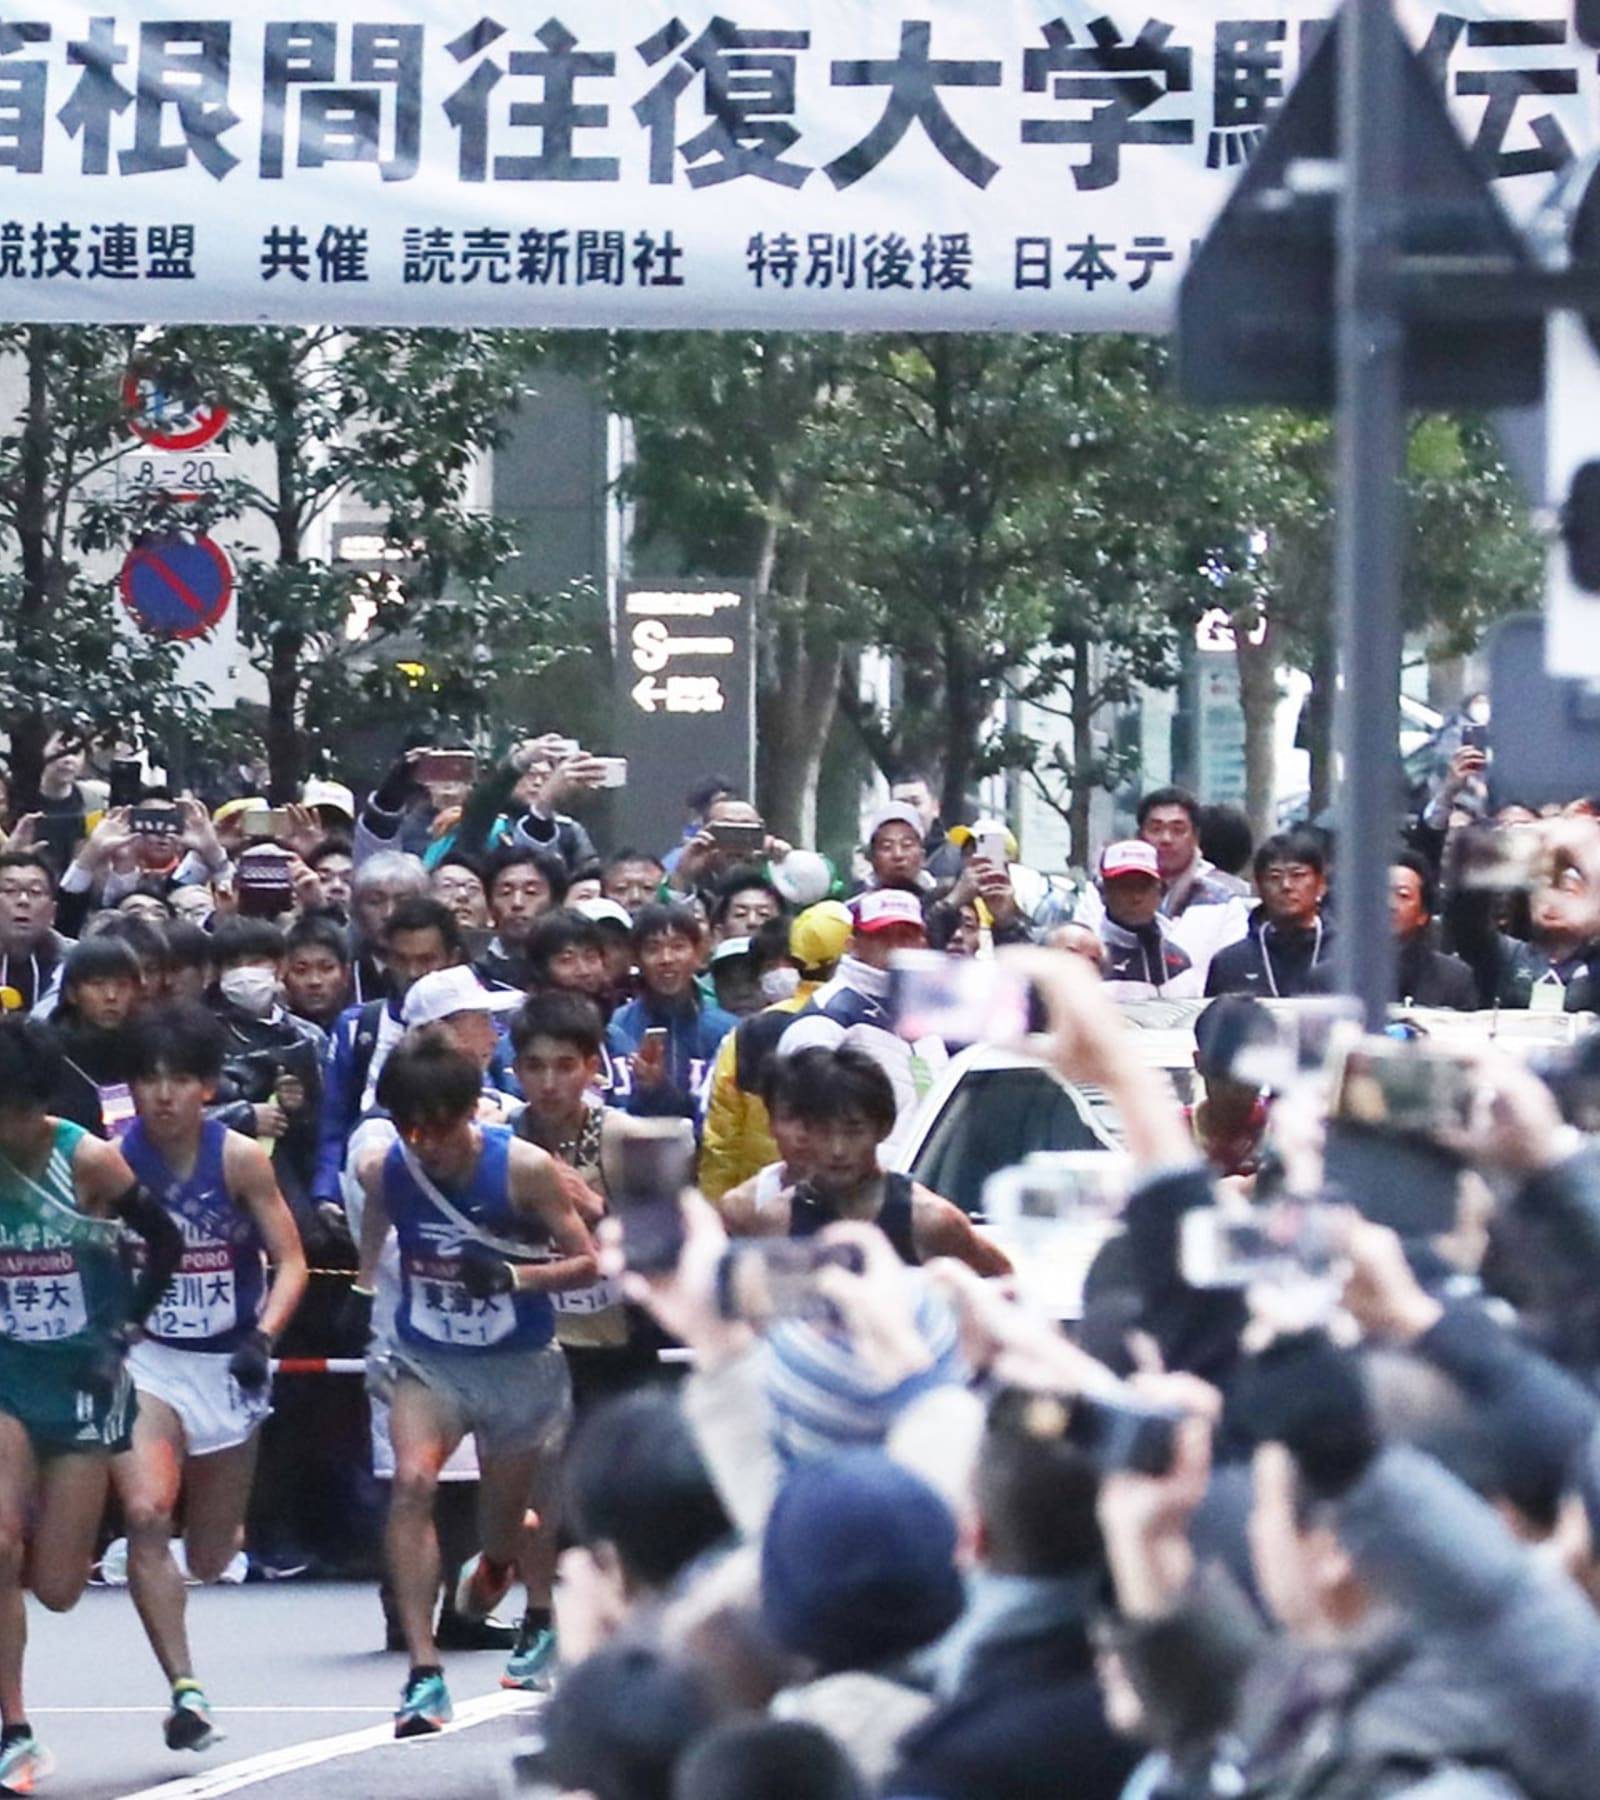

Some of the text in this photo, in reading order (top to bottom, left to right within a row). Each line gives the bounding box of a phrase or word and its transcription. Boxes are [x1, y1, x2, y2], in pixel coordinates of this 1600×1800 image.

[261, 226, 369, 284] 共催
[403, 228, 686, 288] 読売新聞社
[746, 231, 974, 291] 特別後援
